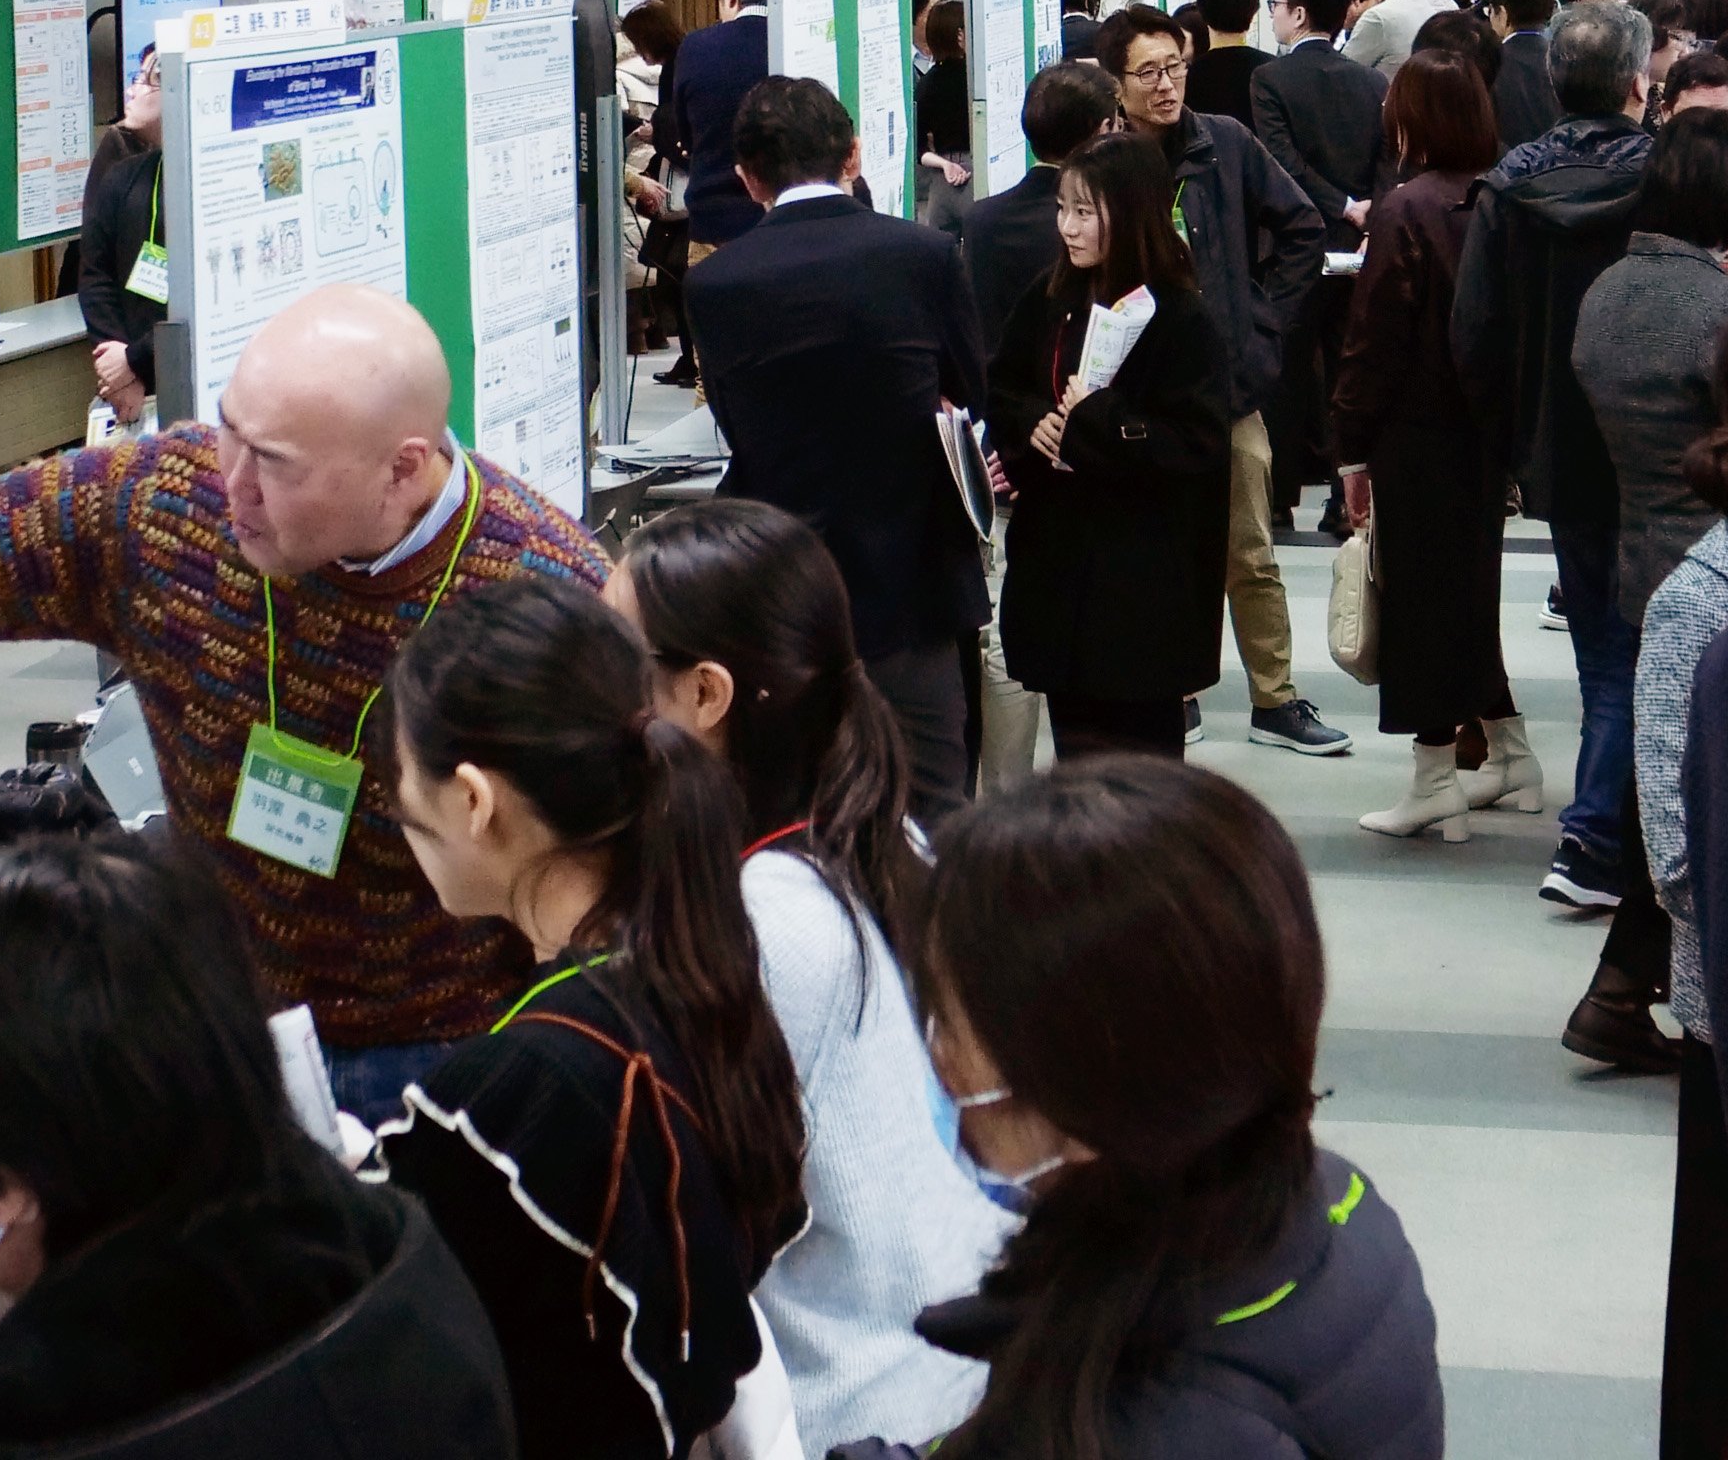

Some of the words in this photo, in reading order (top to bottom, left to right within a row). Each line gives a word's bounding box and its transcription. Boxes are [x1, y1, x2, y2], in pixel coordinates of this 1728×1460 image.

[579, 112, 589, 172] iiyama
[266, 767, 325, 801] 出展者
[252, 791, 286, 818] 羽深
[295, 810, 328, 837] 典之
